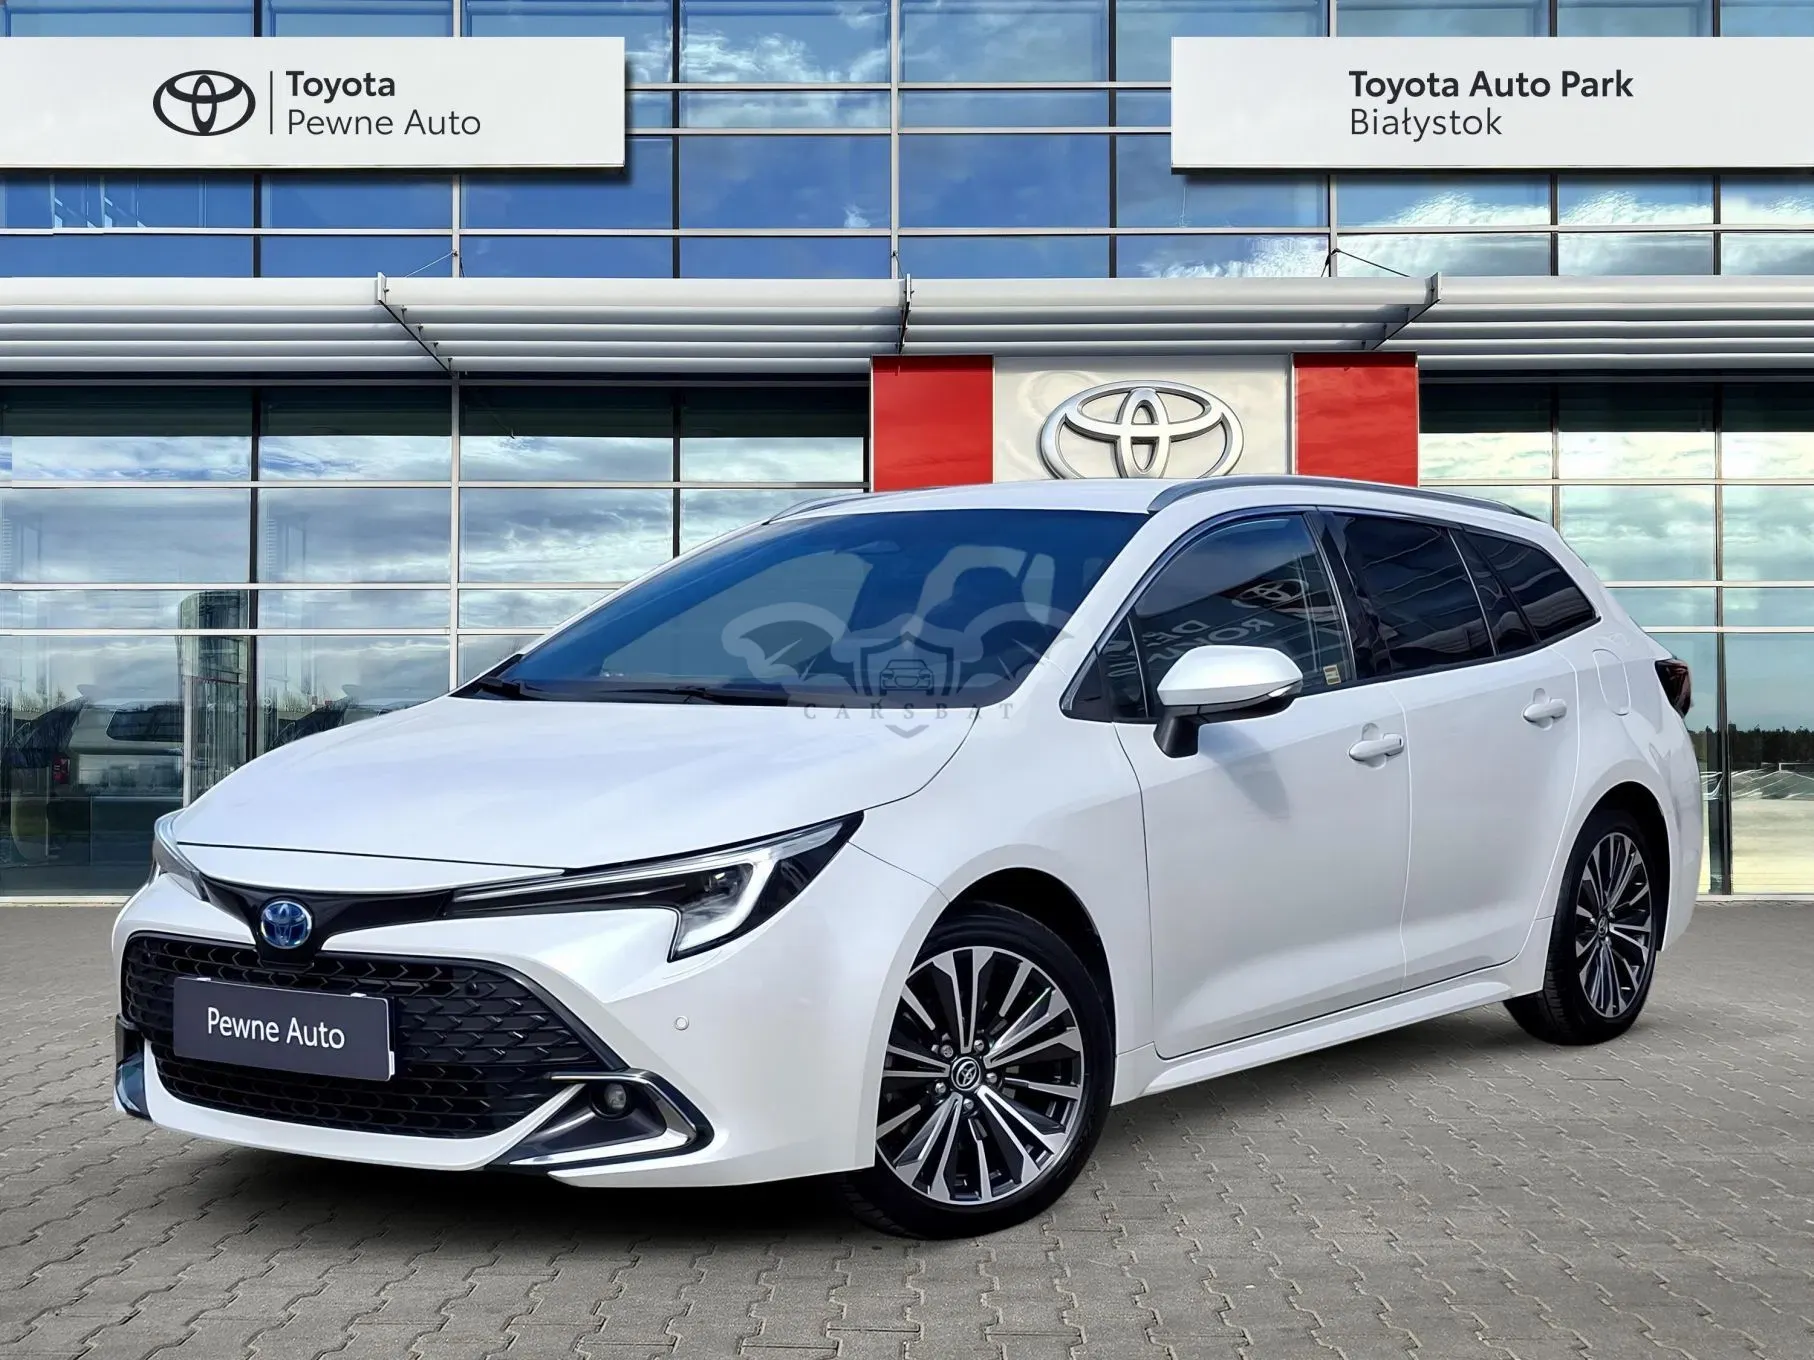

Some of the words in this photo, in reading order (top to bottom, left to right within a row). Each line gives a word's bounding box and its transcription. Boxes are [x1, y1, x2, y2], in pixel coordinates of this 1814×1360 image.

[286, 70, 395, 103] Toyota
[1349, 70, 1459, 103] Toyota
[1469, 70, 1551, 98] Auto
[1562, 69, 1634, 98] Park
[288, 109, 394, 135] Pewne
[404, 109, 481, 135] Auto
[1351, 107, 1502, 143] Białystok
[207, 1006, 280, 1042] Pewne
[287, 1017, 346, 1049] Auto
